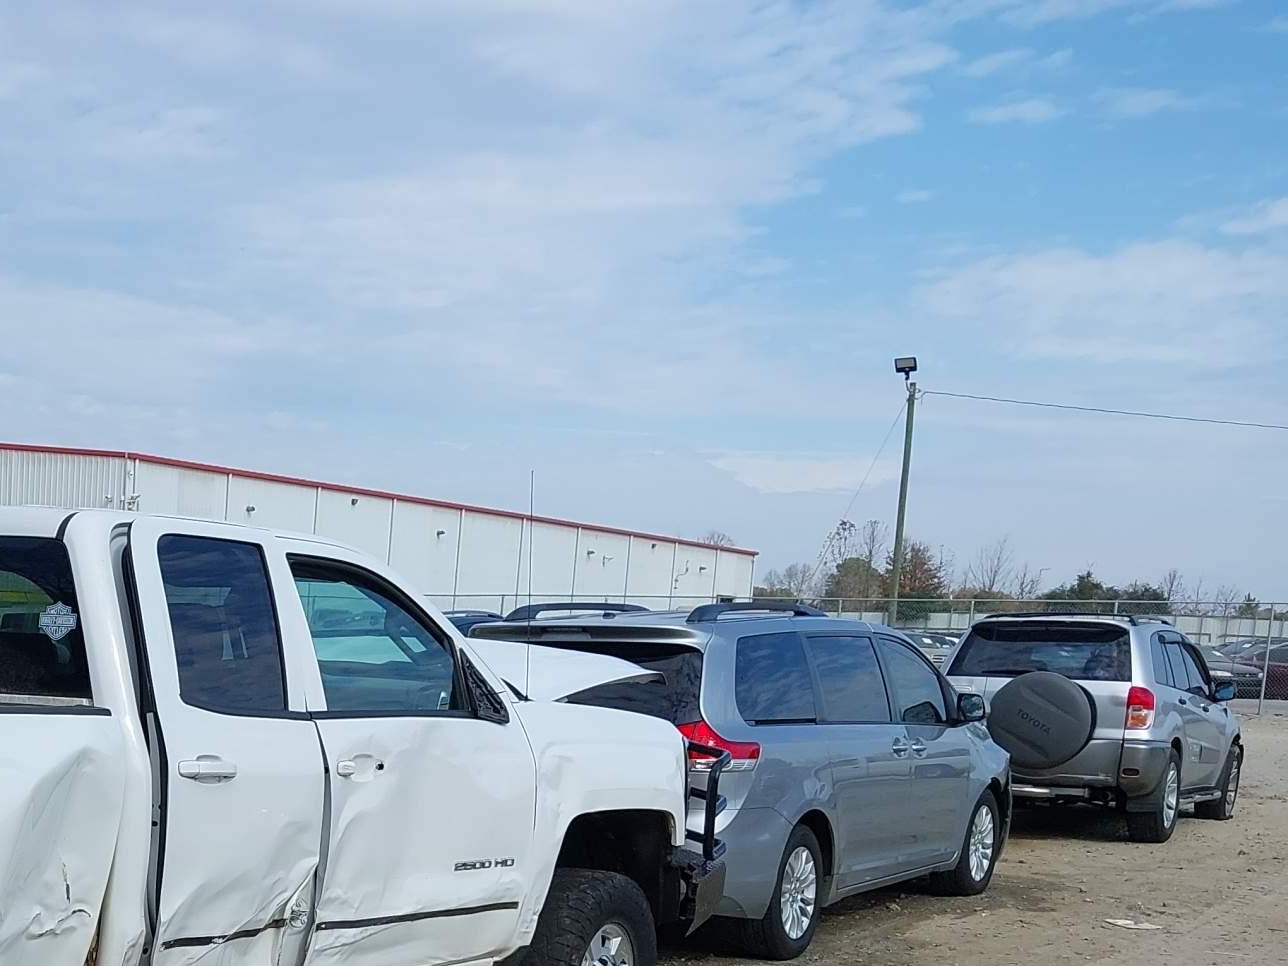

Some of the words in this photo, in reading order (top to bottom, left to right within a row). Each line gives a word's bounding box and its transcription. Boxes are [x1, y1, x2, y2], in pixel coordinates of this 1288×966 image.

[1018, 708, 1051, 736] TOYOTA
[453, 860, 492, 872] 2500
[494, 858, 515, 868] HD
